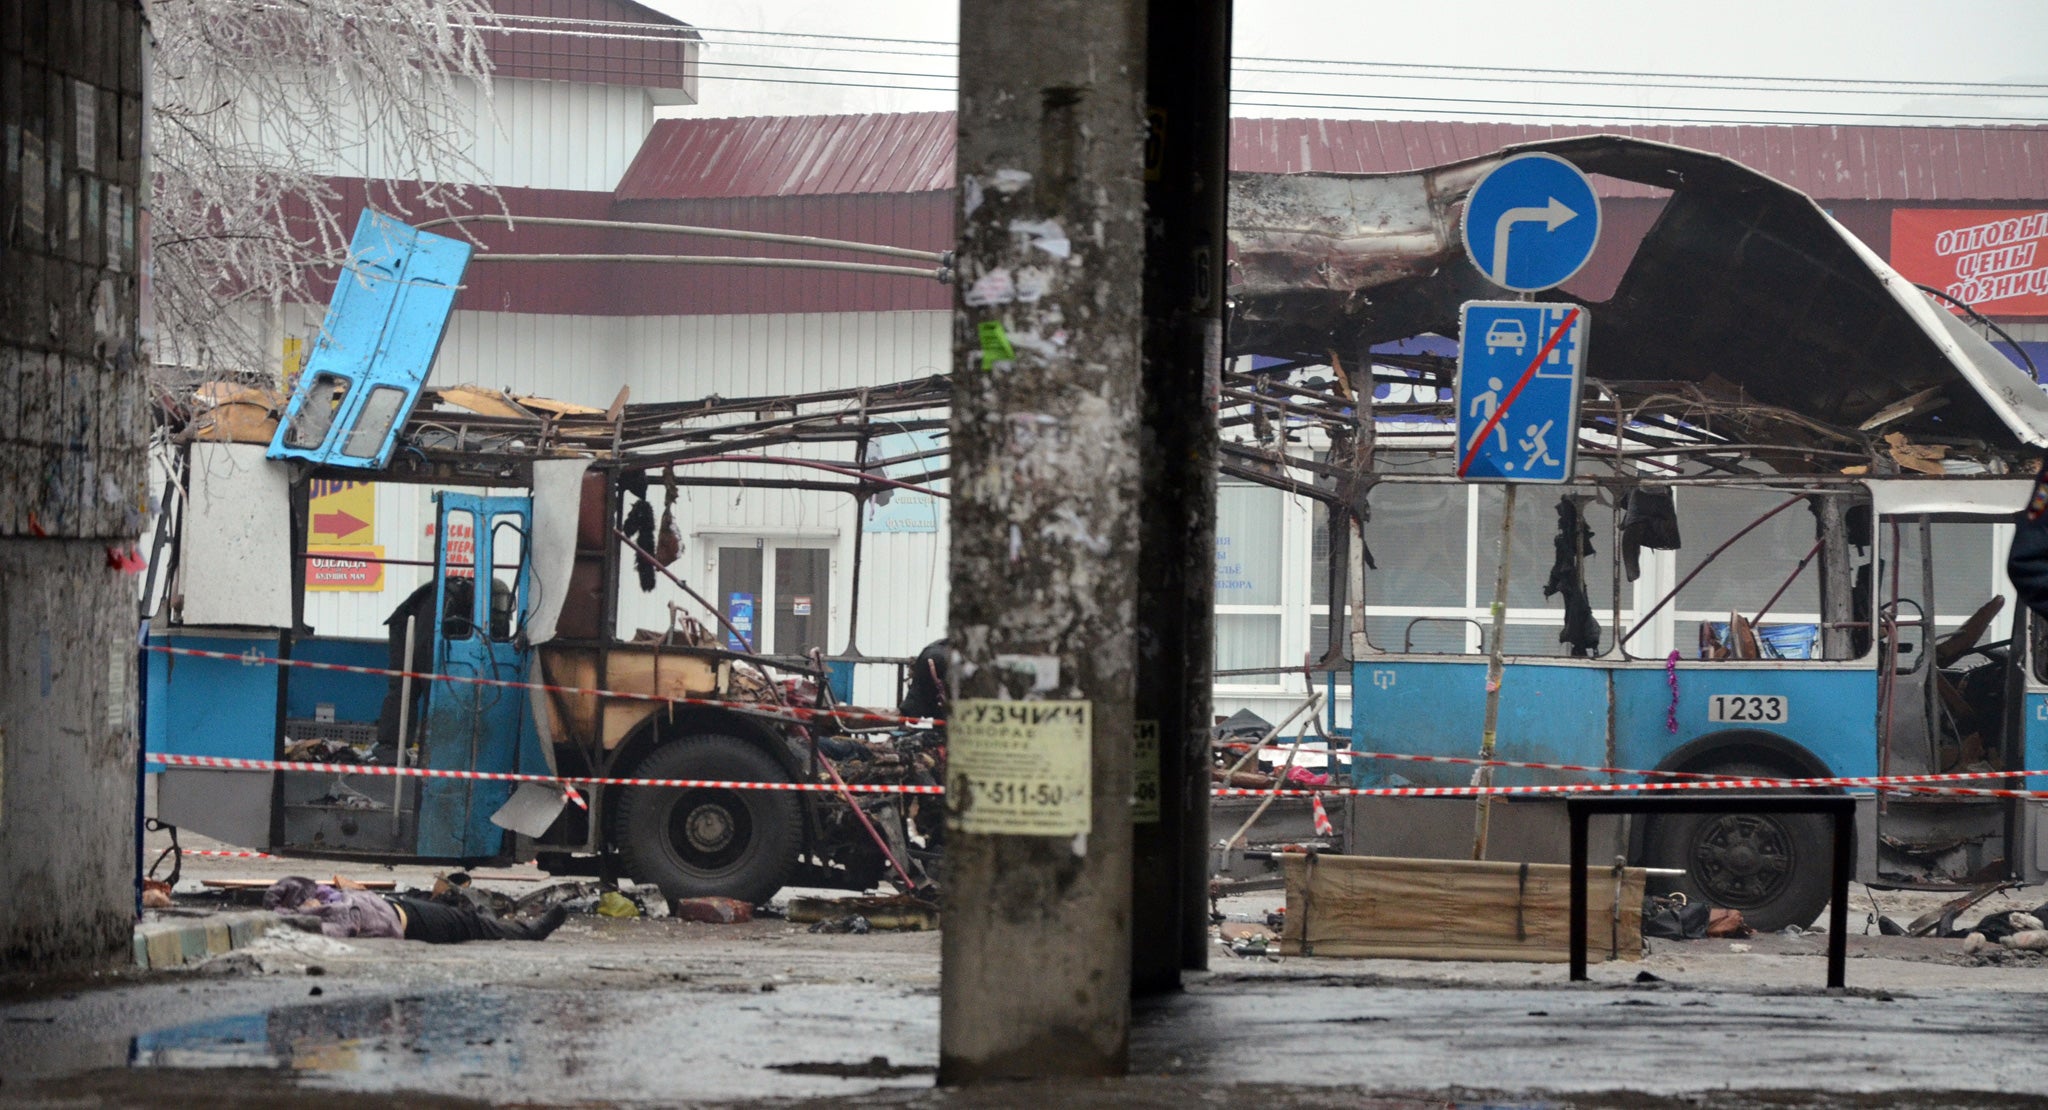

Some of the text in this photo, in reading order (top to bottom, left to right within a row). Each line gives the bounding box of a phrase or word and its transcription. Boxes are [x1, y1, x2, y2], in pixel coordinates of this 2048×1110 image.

[1956, 241, 2038, 280] ЦЕНЫ
[350, 573, 366, 581] МАМ
[1715, 696, 1781, 721] 1233
